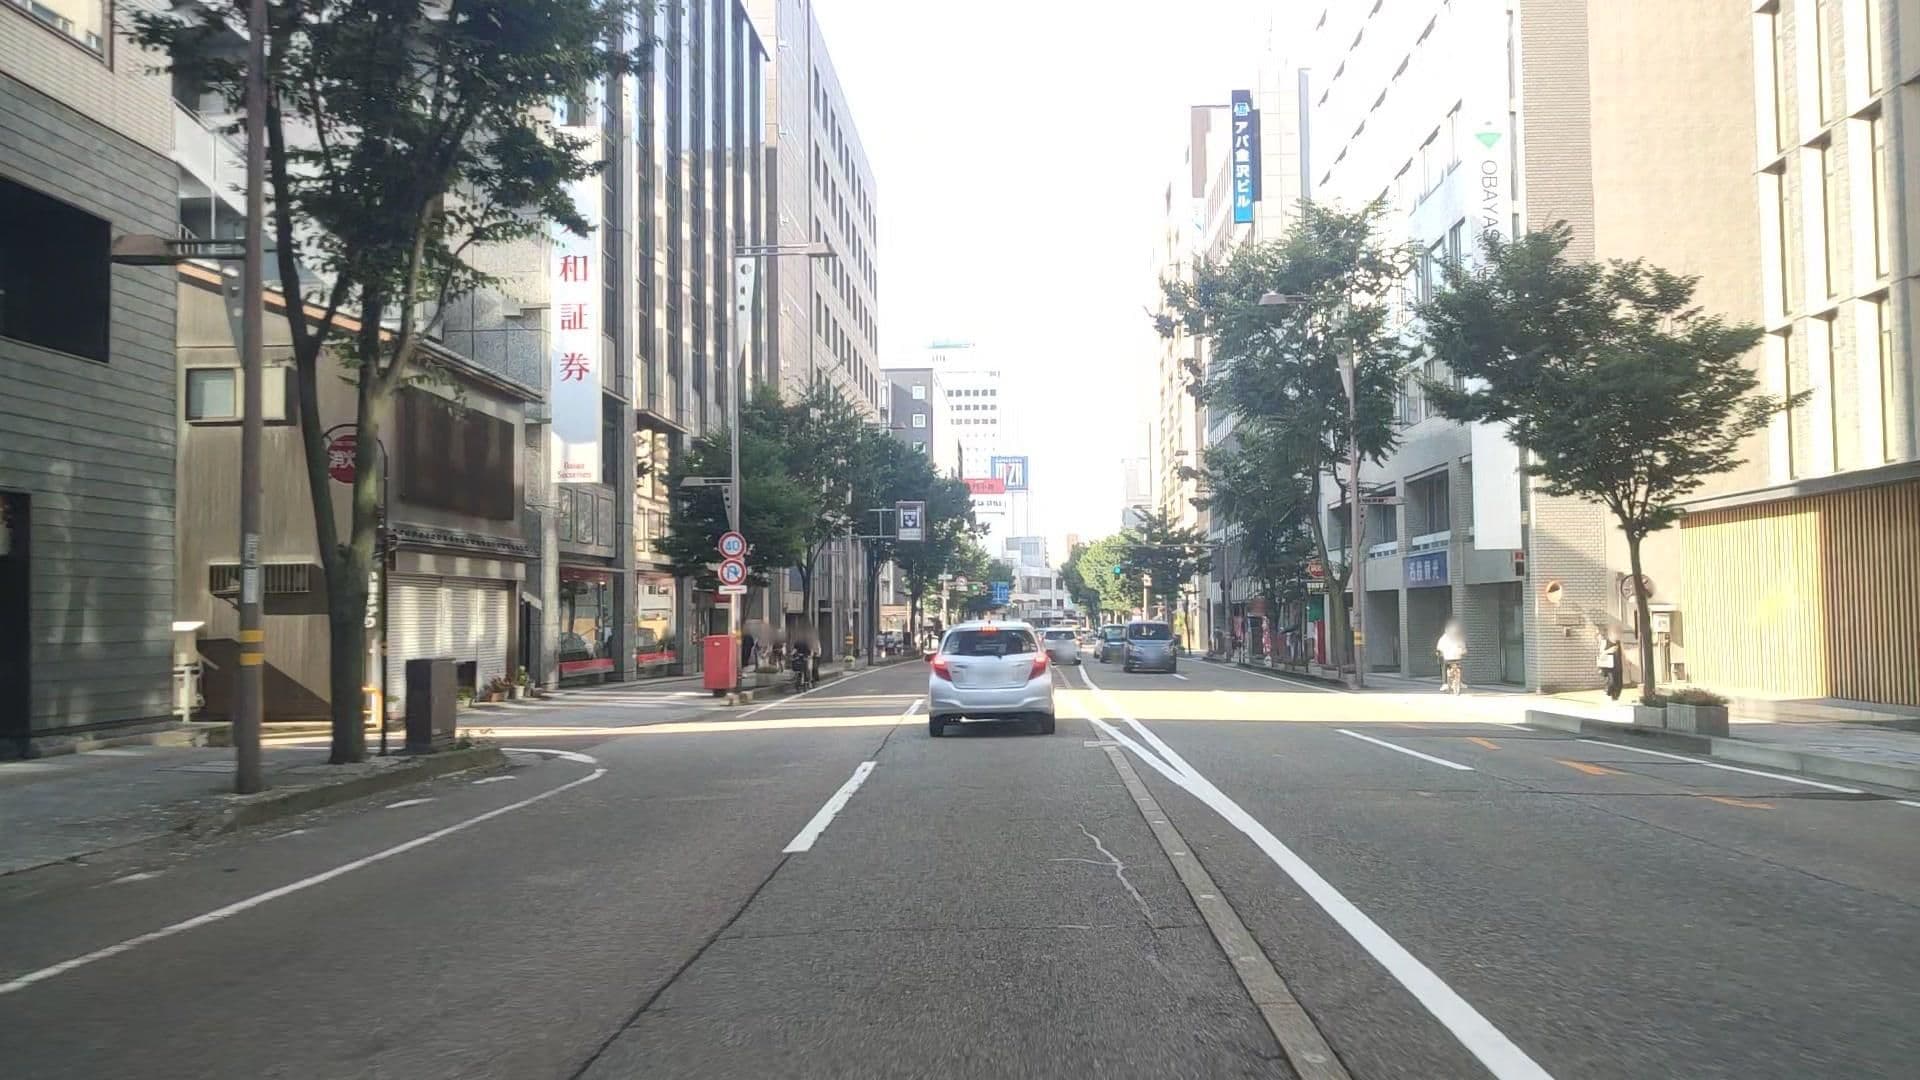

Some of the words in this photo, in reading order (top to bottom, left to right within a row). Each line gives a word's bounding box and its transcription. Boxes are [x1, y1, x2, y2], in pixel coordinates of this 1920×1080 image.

[1481, 160, 1500, 243] OBAYAS
[560, 226, 591, 382] 和証券
[328, 449, 357, 469] 消火
[725, 540, 740, 551] 40
